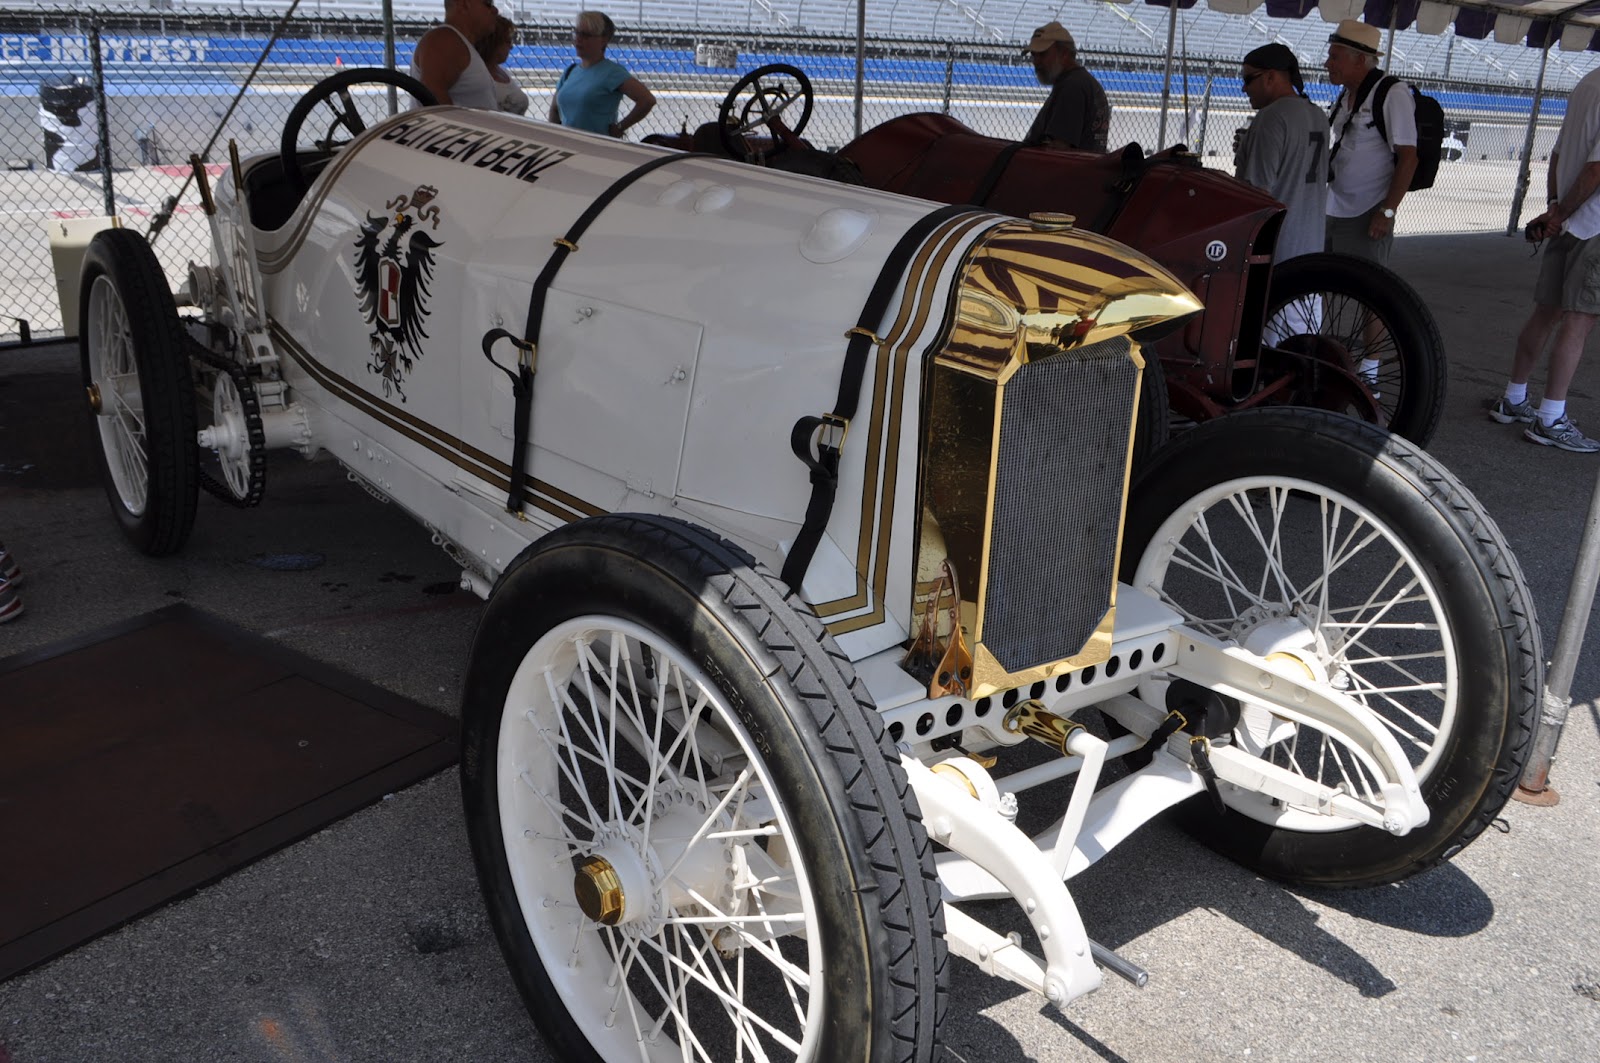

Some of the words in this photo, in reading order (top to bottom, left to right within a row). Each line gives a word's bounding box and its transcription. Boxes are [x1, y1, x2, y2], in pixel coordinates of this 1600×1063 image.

[381, 117, 499, 163] BLITZEN
[474, 138, 575, 184] BENZ
[1305, 131, 1325, 184] 7
[703, 654, 772, 758] EXCELSIOR
